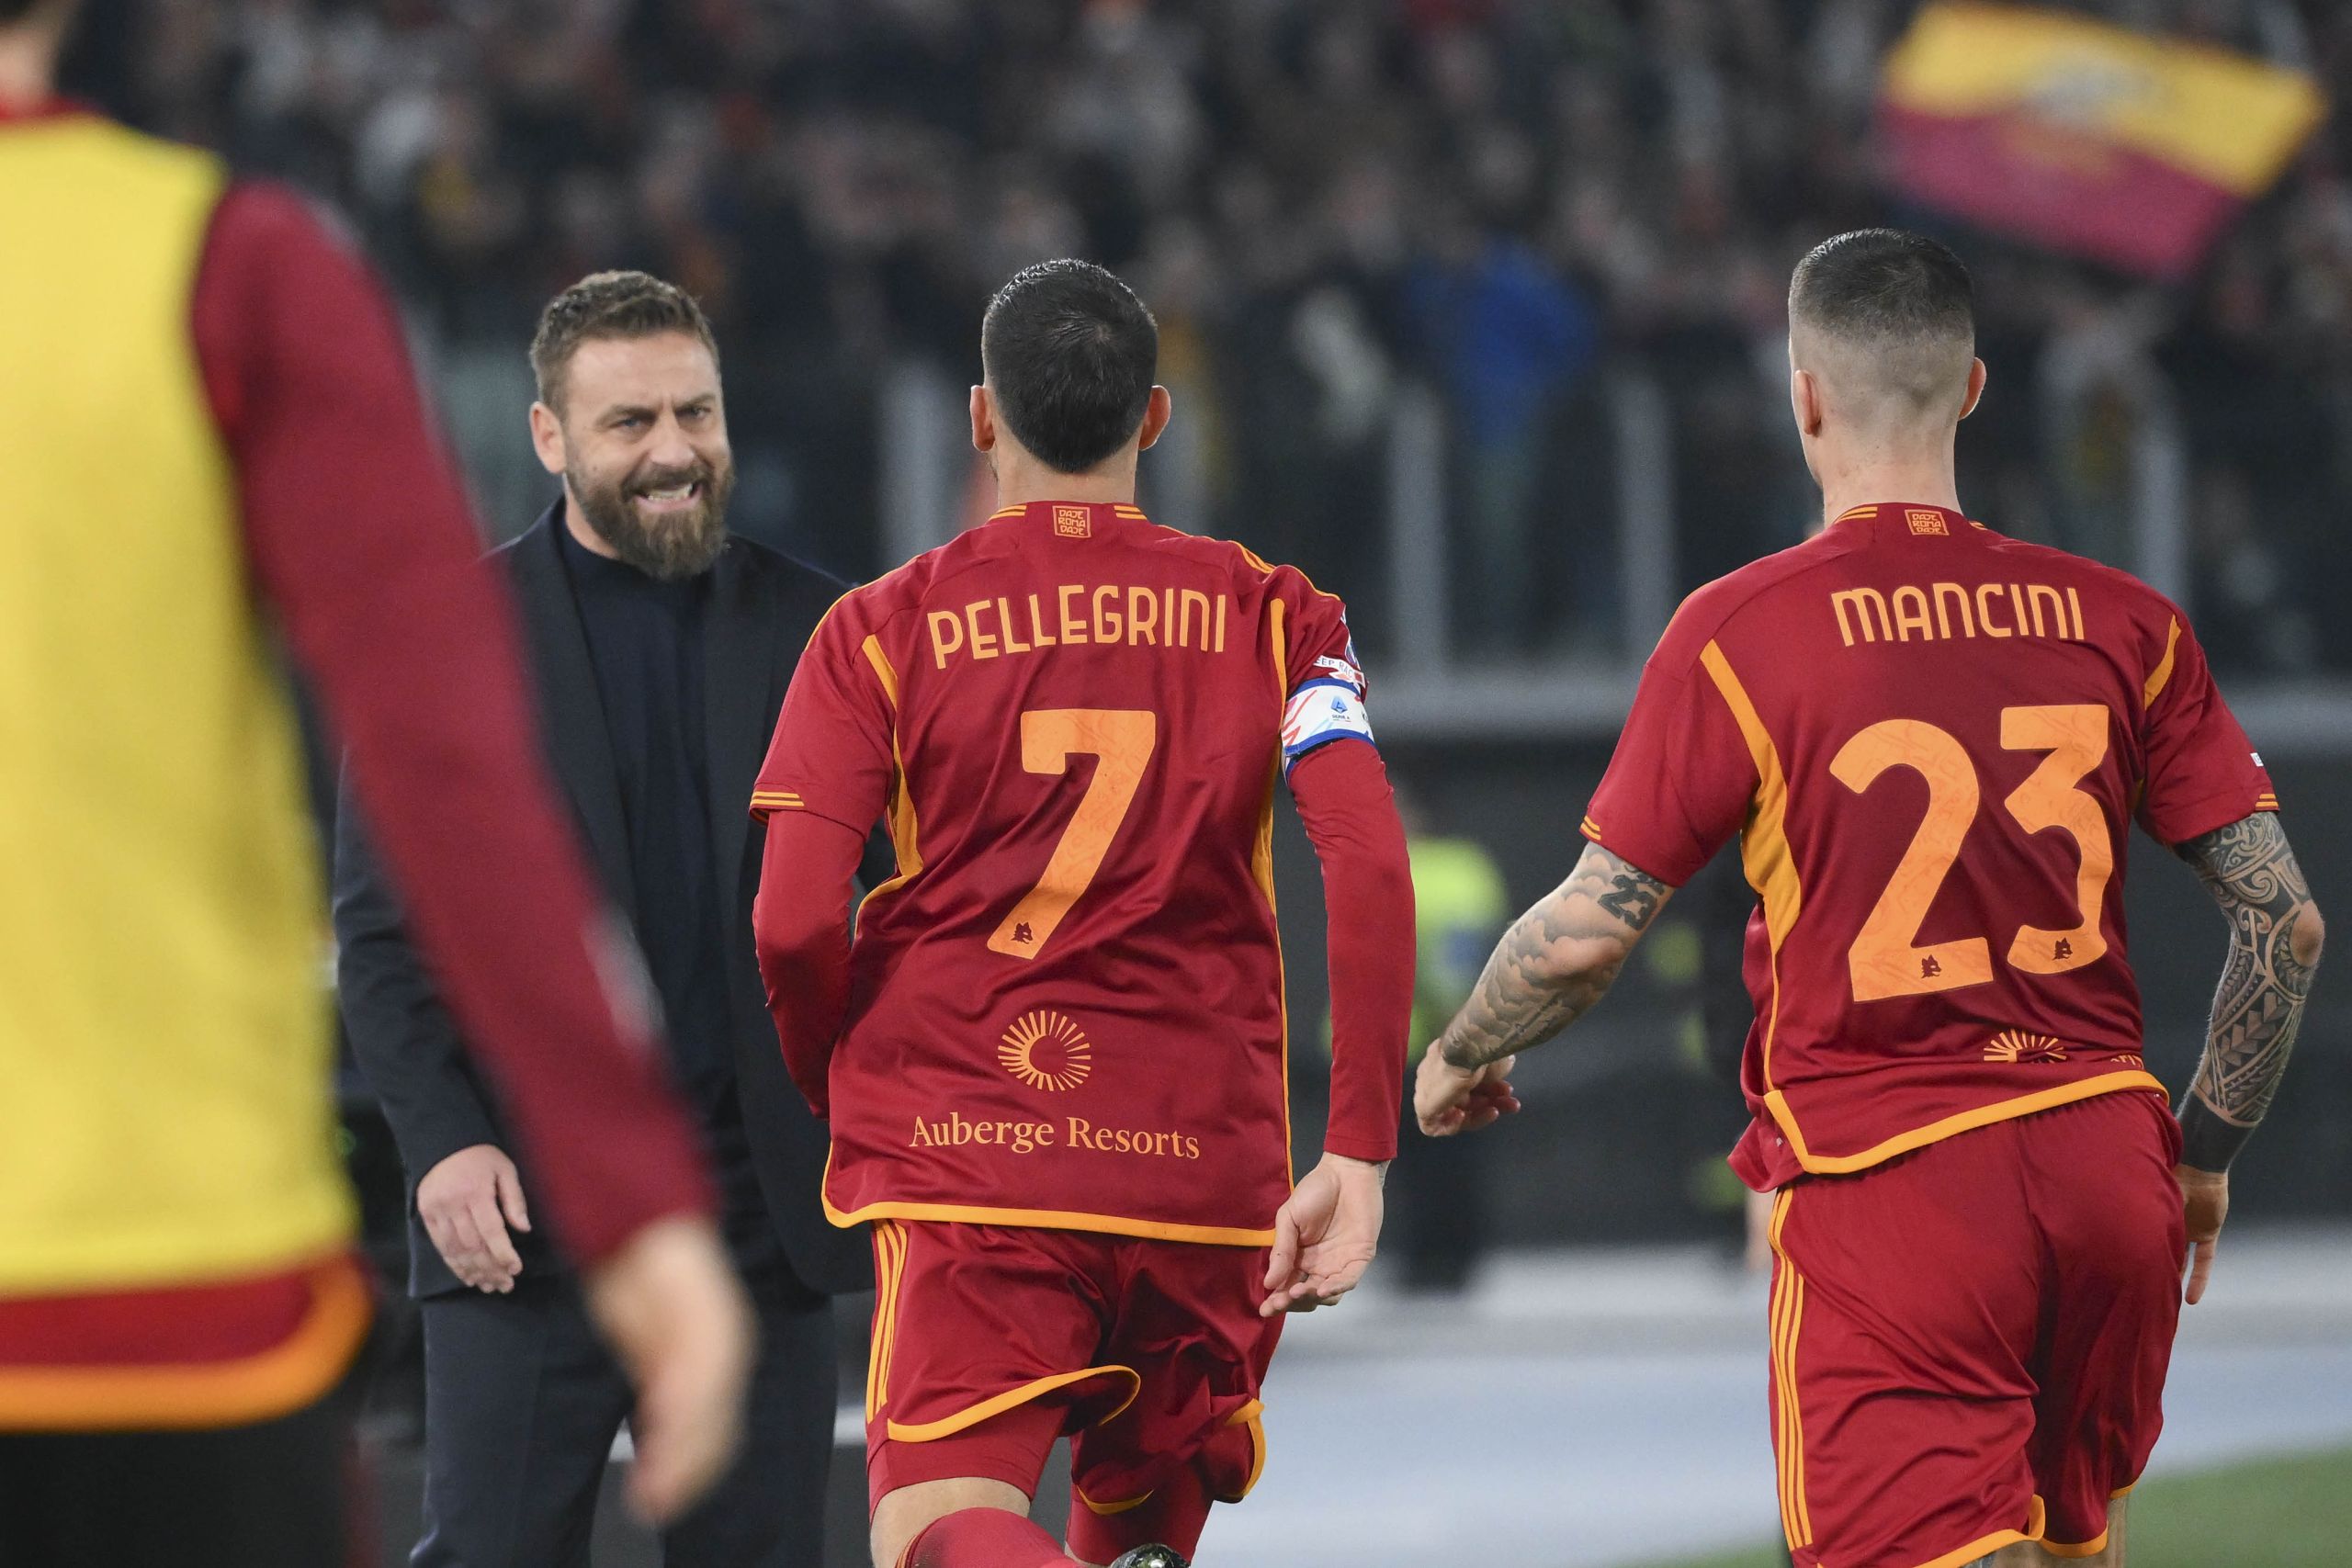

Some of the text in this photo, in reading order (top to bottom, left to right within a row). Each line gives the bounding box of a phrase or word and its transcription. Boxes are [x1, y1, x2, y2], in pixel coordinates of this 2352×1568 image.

[1058, 510, 1083, 519] DAJE
[1058, 517, 1086, 527] ROMA
[1060, 525, 1085, 536] DAJE
[927, 584, 1227, 670] PELLEGRINI
[1829, 583, 2086, 648] MANCINI
[986, 708, 1158, 961] 7
[1828, 704, 2114, 1004] 23
[908, 1111, 1201, 1160] Auberge Resorts
